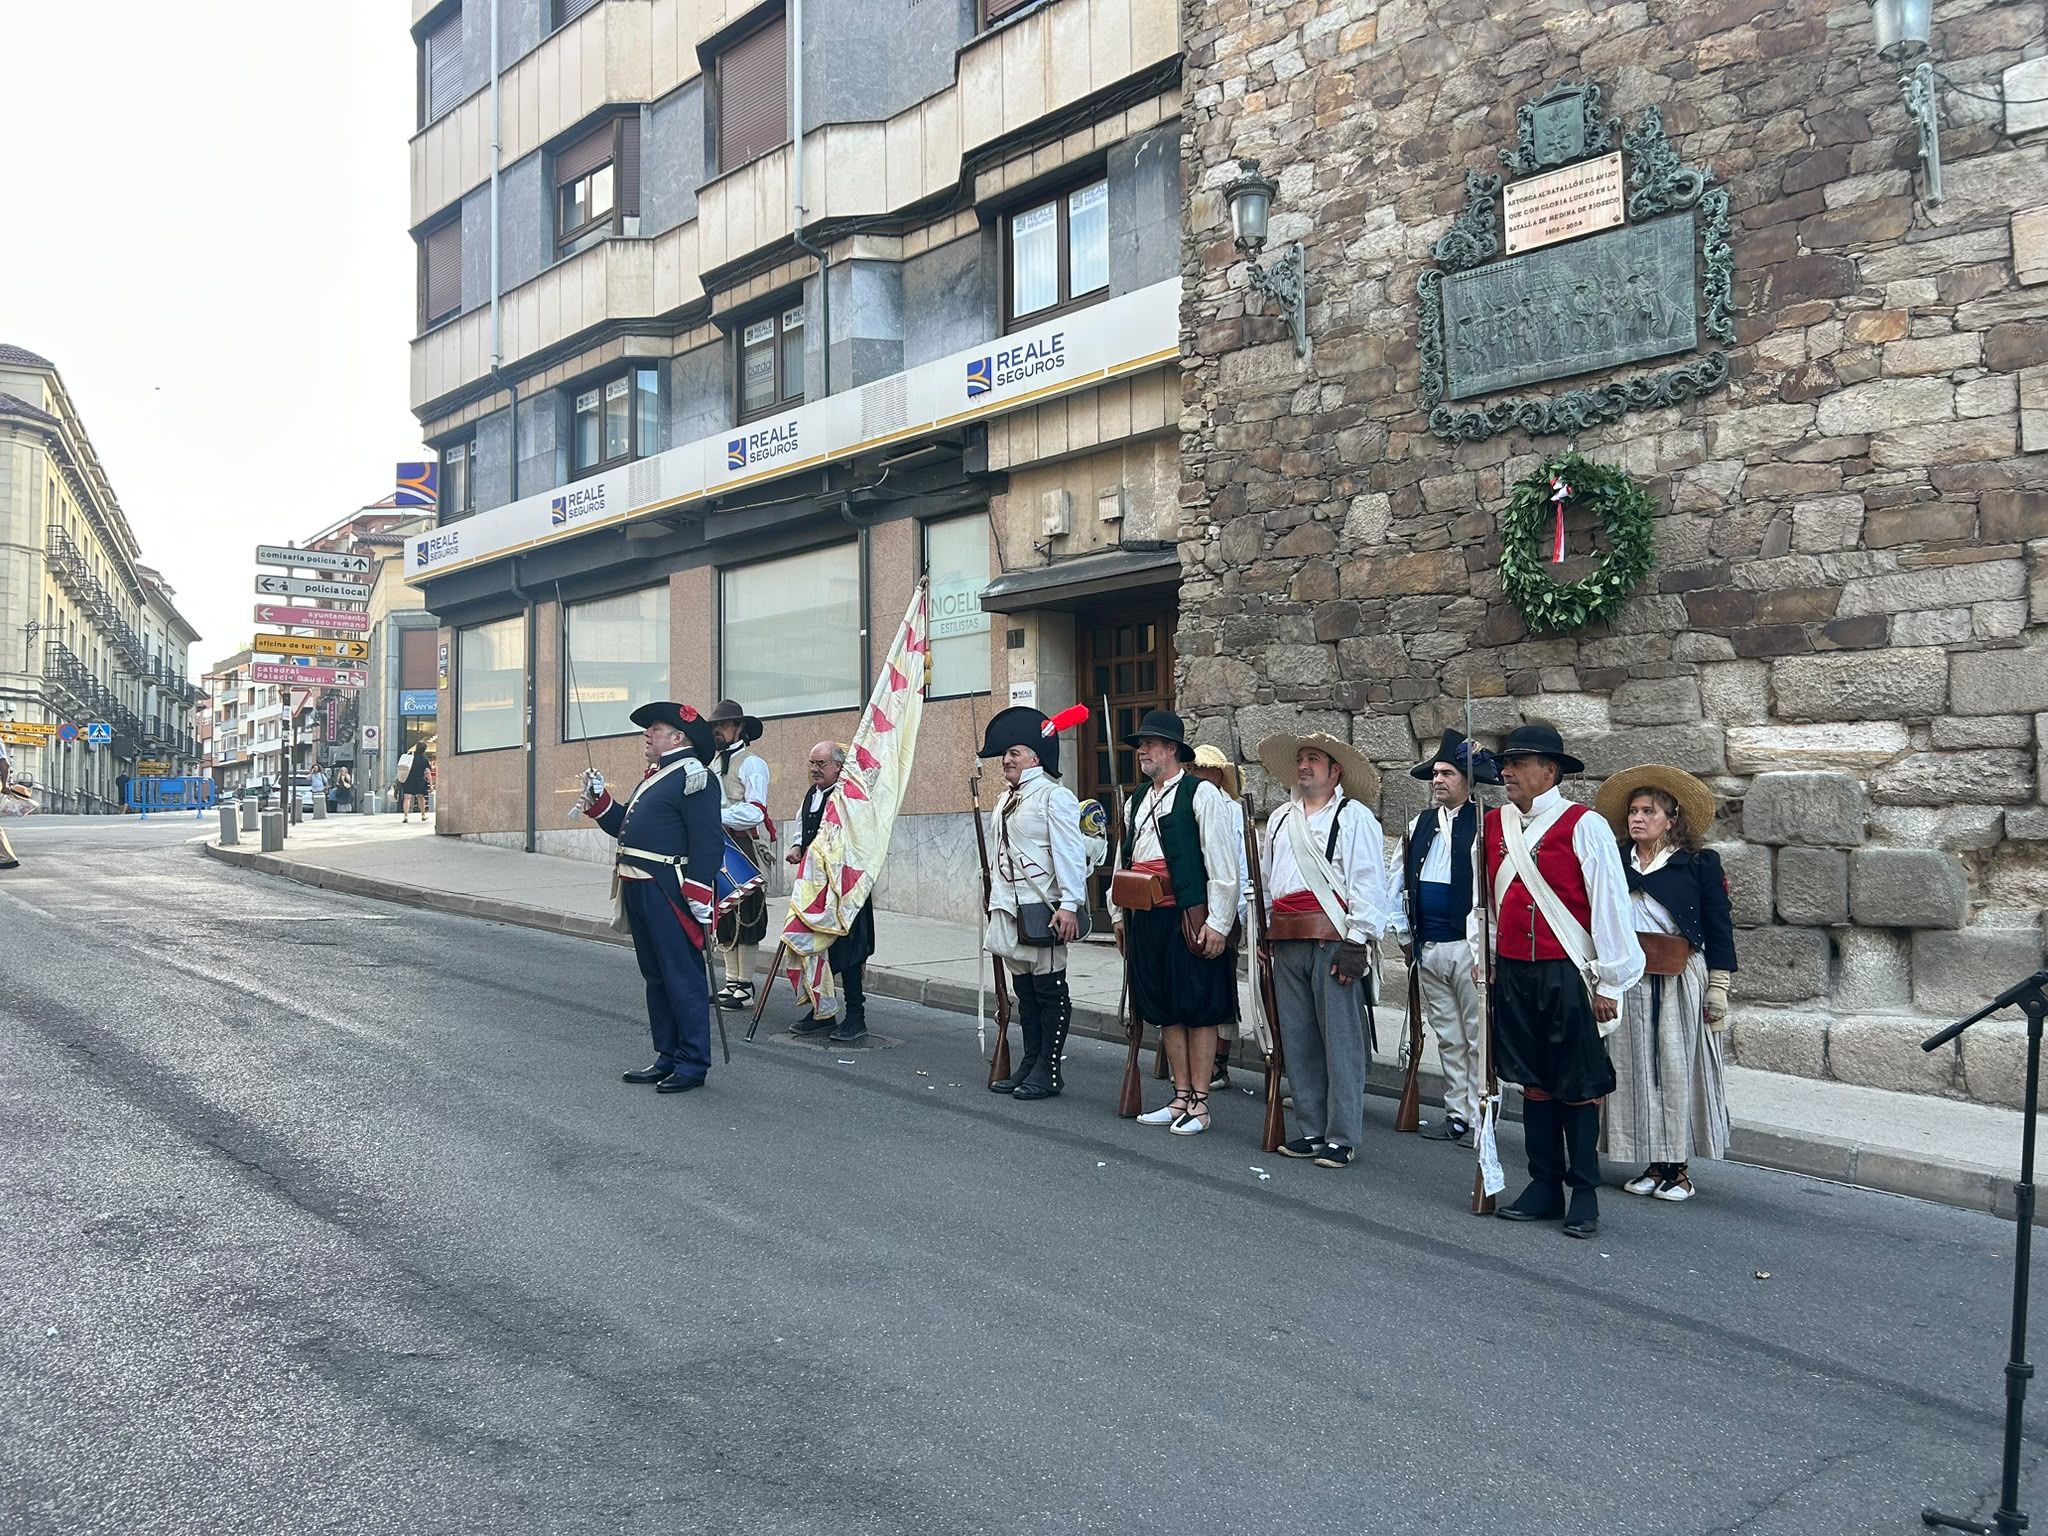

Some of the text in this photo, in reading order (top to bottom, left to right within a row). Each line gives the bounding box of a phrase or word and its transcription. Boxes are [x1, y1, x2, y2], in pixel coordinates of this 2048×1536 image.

[997, 332, 1065, 371] REALE
[997, 354, 1065, 386] SEGUROS
[750, 421, 798, 450] REALE
[750, 440, 798, 463] SEGUROS
[568, 484, 605, 508] REALE
[568, 500, 605, 518] SEGUROS
[430, 532, 458, 551] REALE
[430, 545, 458, 561] SEGUROS
[341, 586, 366, 596] local
[302, 618, 366, 628] museo romano
[308, 612, 366, 622] ayuntamiento
[940, 618, 978, 634] ESTILISTAS
[258, 640, 286, 648] oficina
[256, 666, 300, 674] catedral
[256, 672, 293, 681] Palaci
